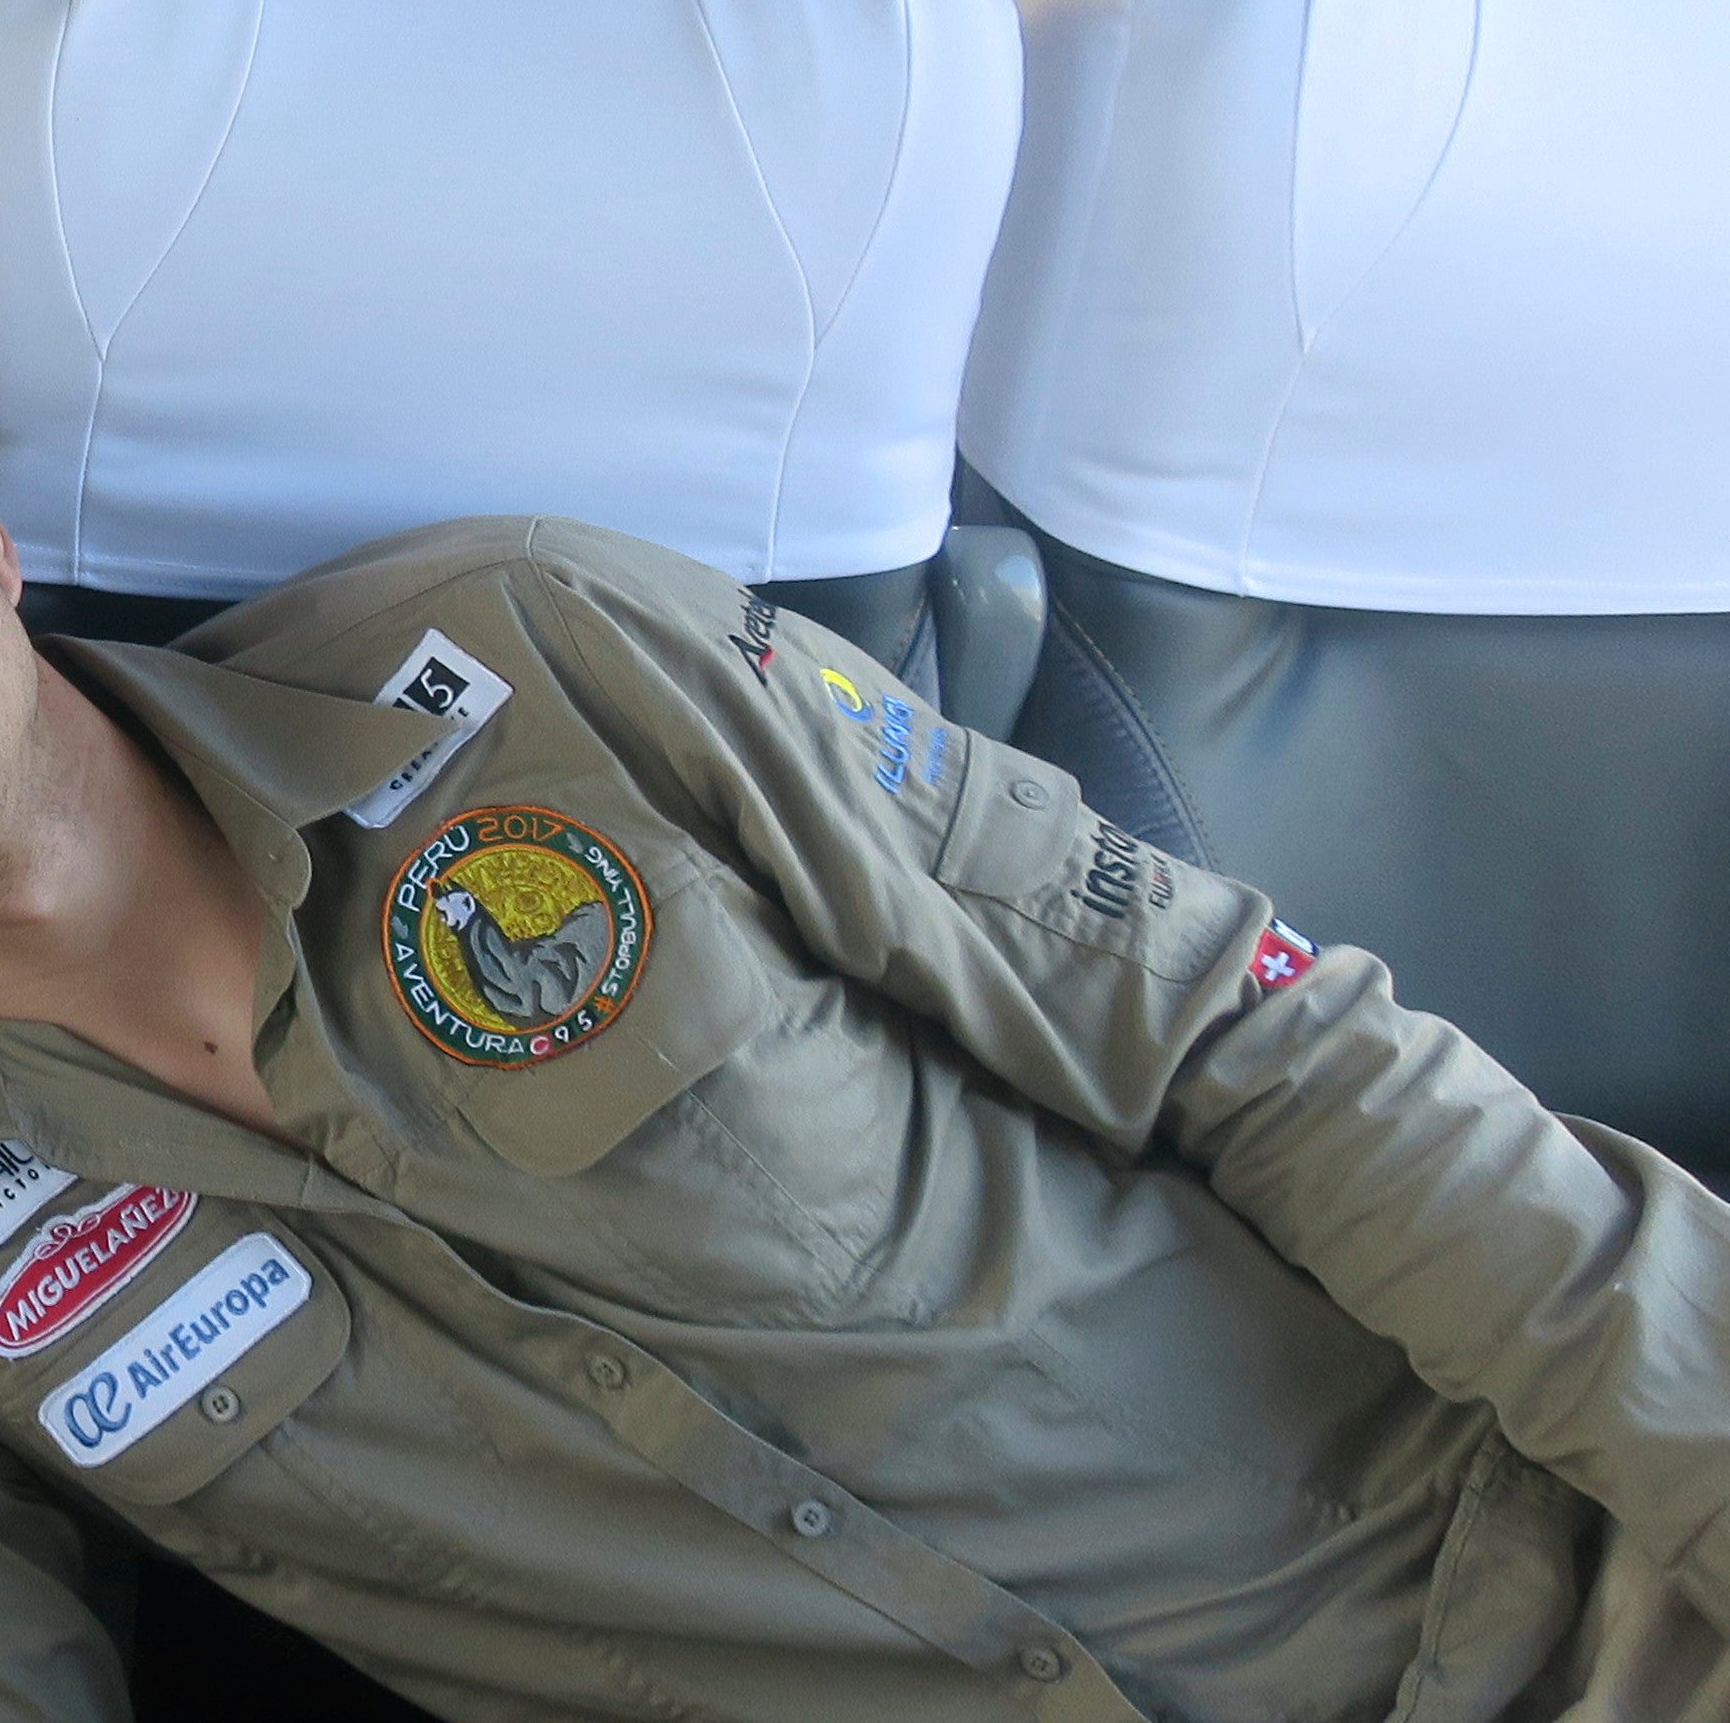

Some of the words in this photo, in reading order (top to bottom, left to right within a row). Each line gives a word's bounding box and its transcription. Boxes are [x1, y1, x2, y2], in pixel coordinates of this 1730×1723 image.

[475, 815, 565, 843] 2017
[1069, 820, 1139, 920] insta
[395, 940, 524, 1055] AVENTURA
[3, 1186, 177, 1342] MIGUELAÑEZ
[125, 1257, 290, 1400] AirEuropa
